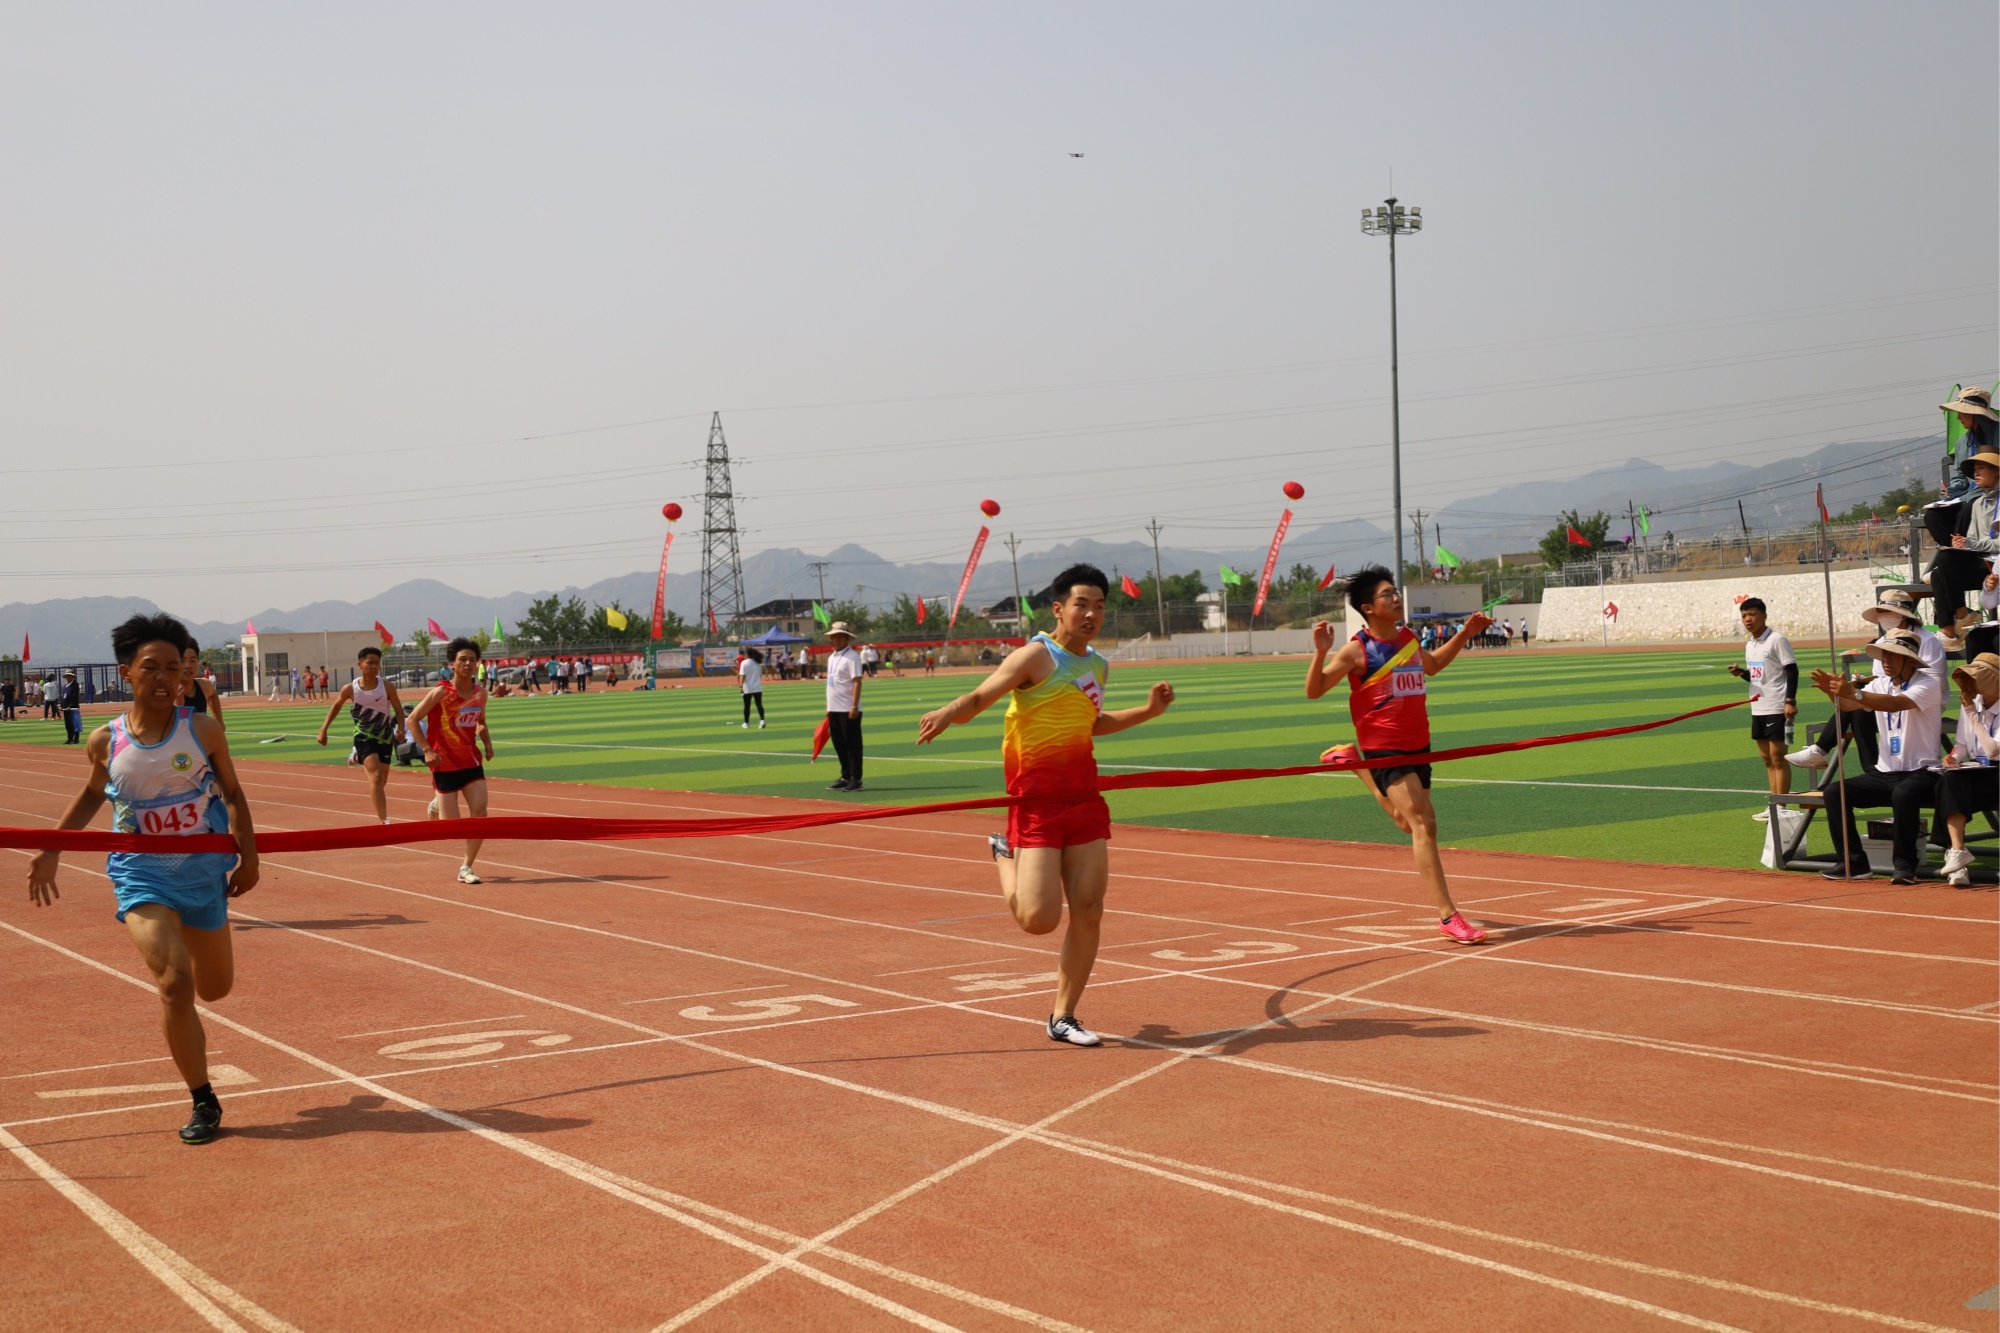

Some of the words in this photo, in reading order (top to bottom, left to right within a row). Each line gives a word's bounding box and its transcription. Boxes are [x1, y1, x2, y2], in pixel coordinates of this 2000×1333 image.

[1396, 673, 1424, 691] 004
[1750, 666, 1762, 678] 28
[144, 803, 198, 833] 043
[1150, 941, 1300, 962] 3
[678, 994, 862, 1021] 5
[377, 1030, 573, 1060] 6
